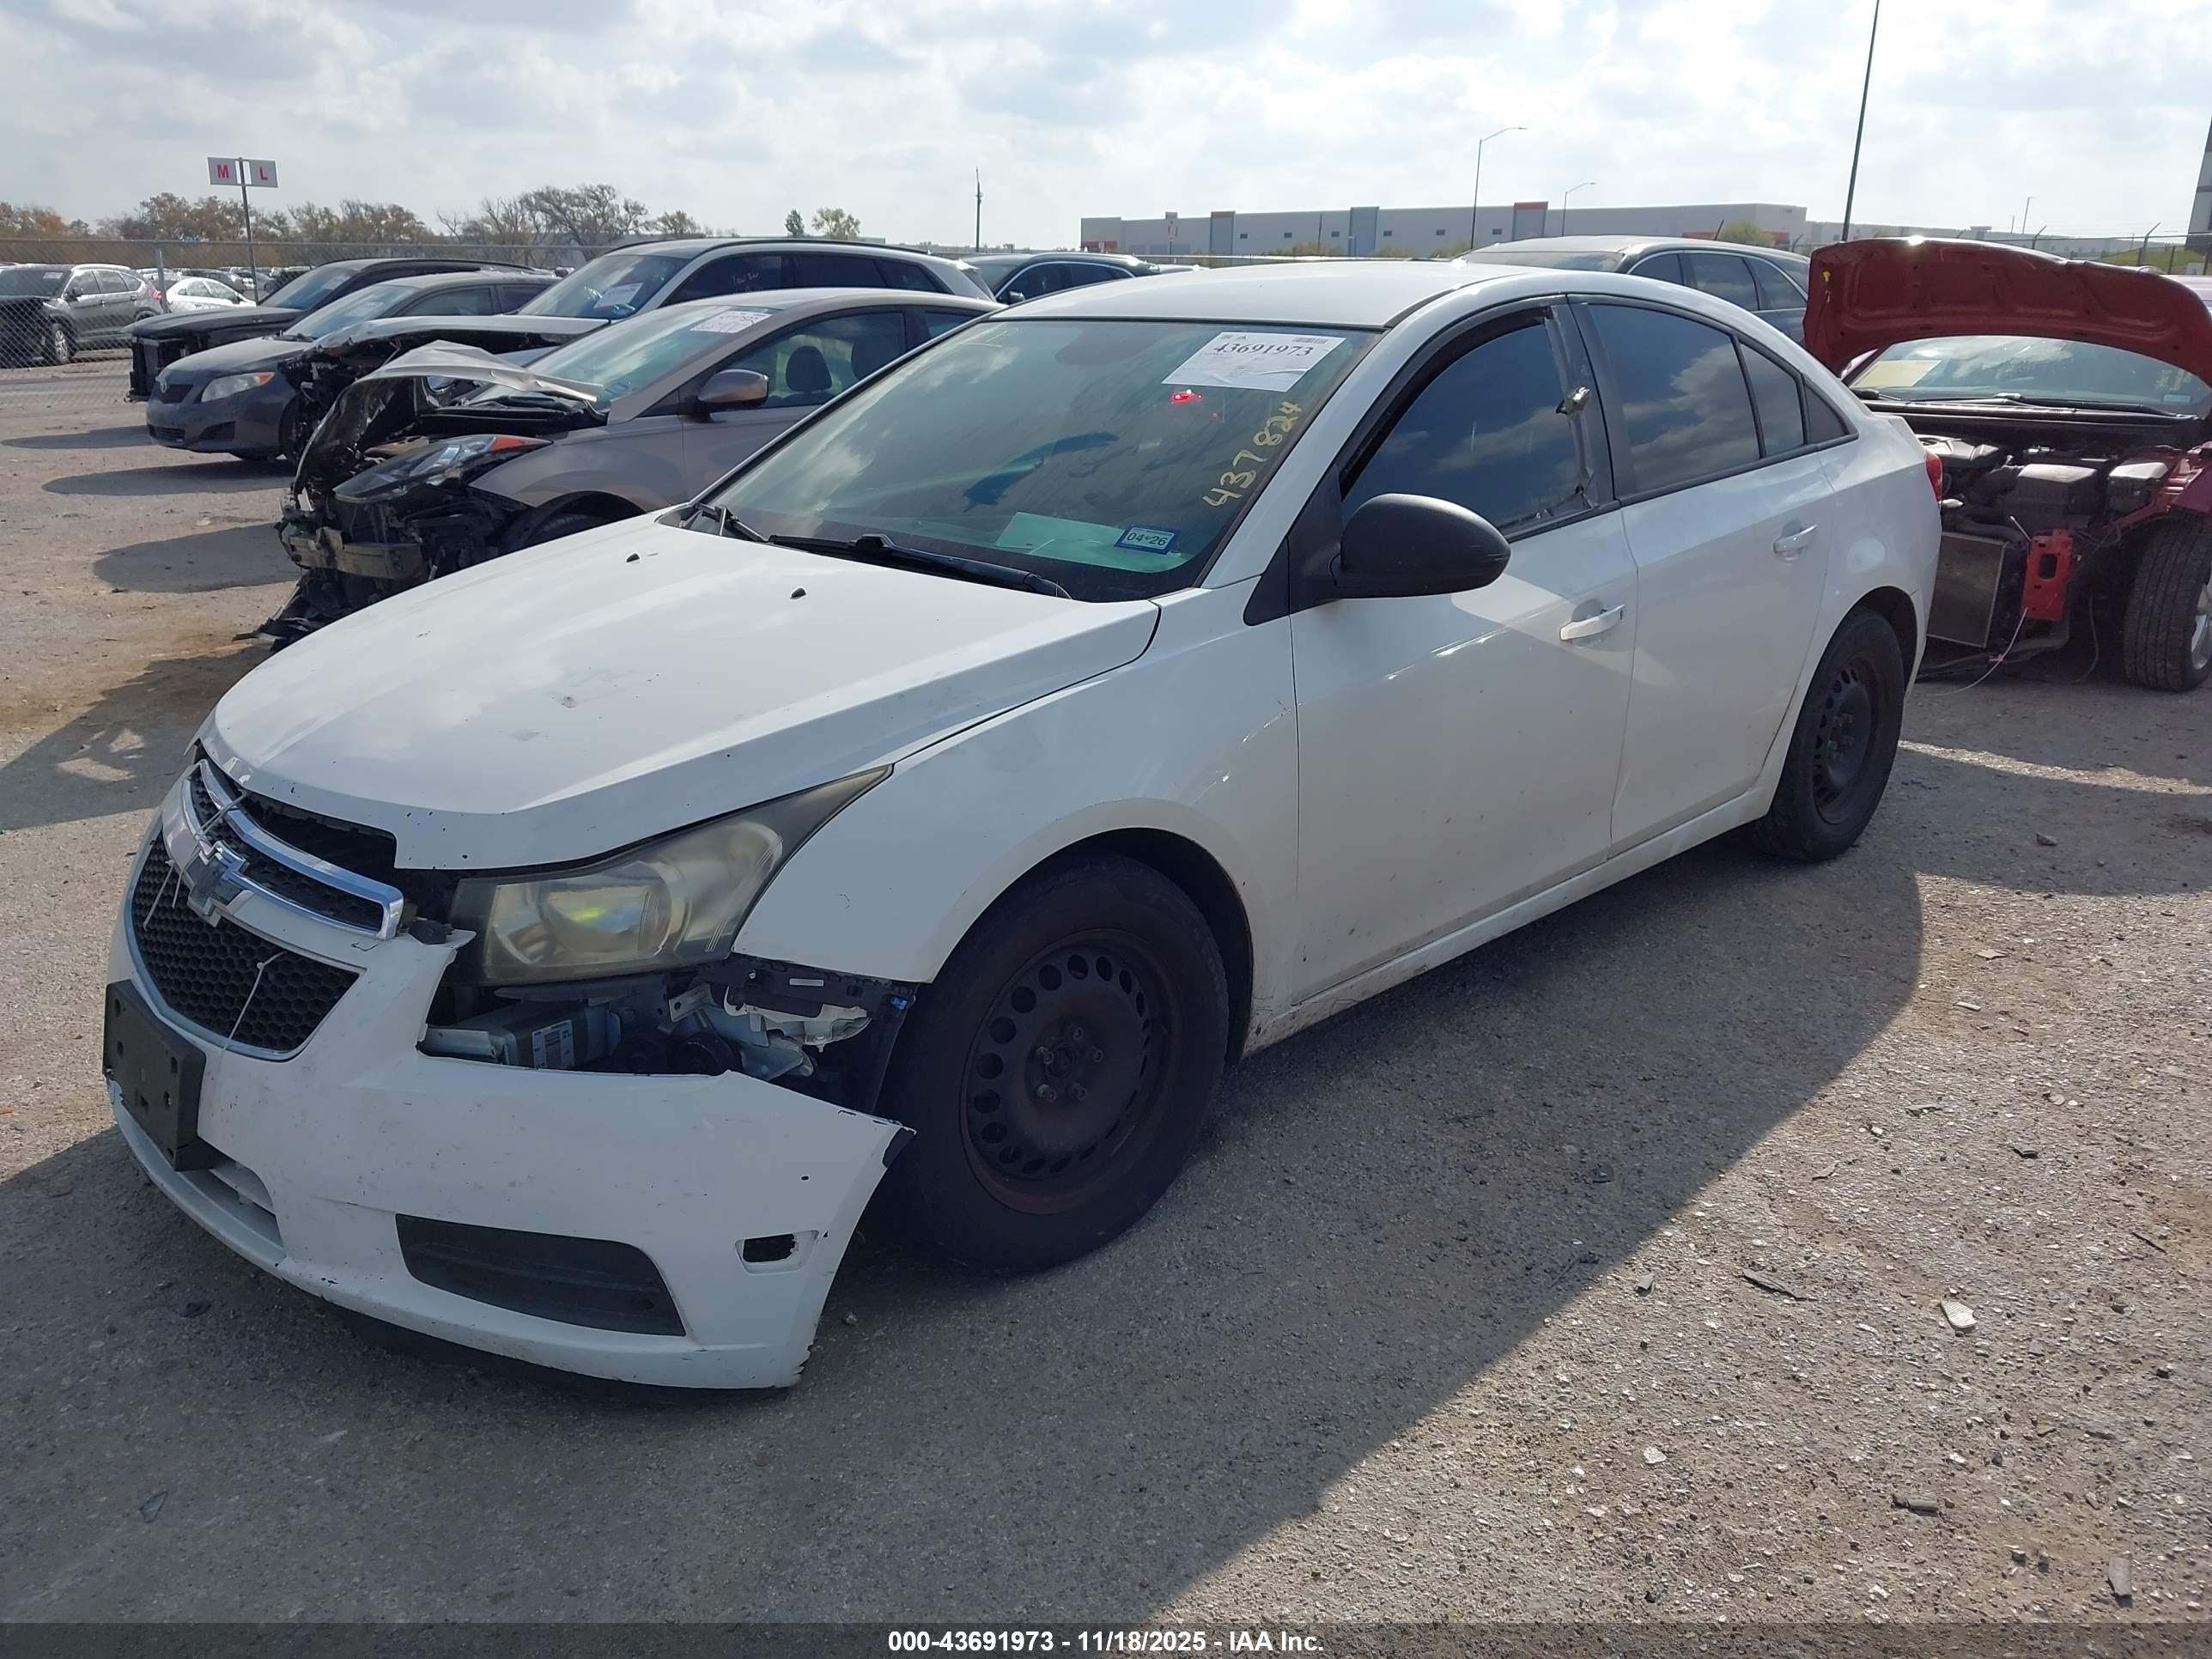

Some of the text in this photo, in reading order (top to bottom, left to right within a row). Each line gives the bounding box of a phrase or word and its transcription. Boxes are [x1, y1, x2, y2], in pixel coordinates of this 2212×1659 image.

[216, 164, 229, 179] M
[259, 166, 269, 180] L
[1213, 343, 1315, 356] 43691973
